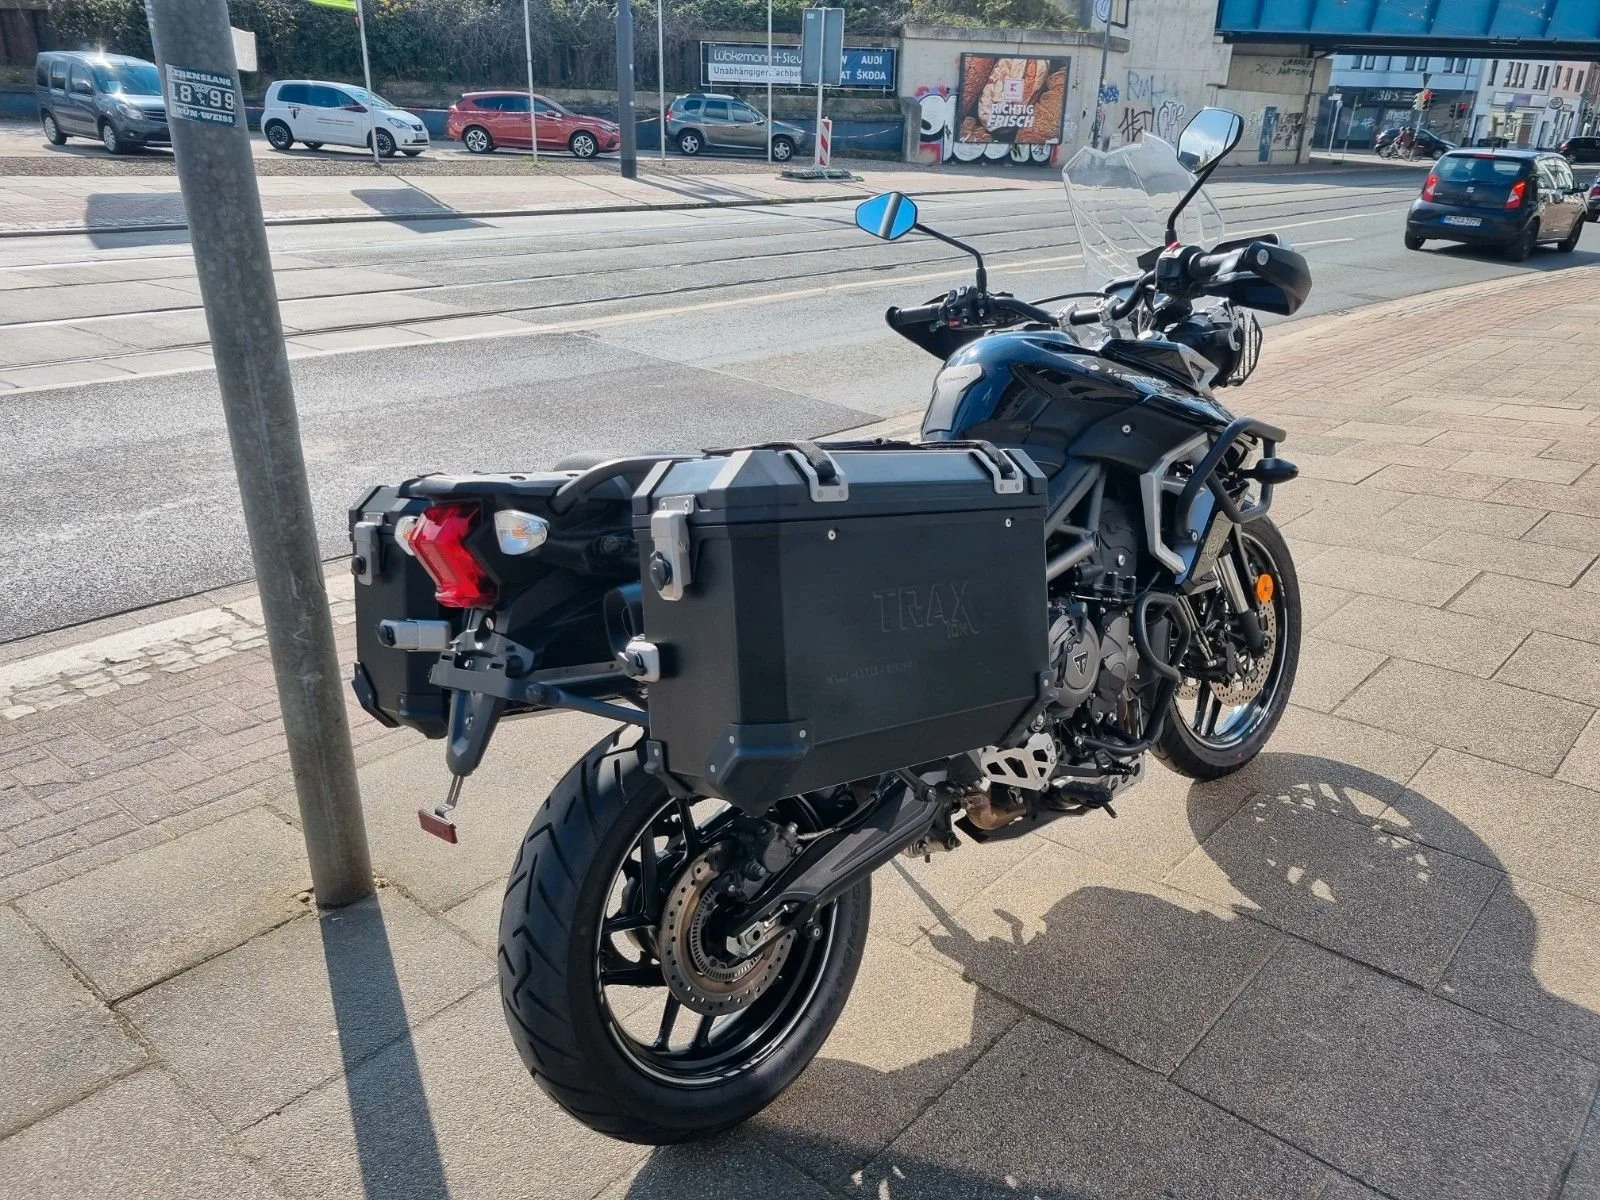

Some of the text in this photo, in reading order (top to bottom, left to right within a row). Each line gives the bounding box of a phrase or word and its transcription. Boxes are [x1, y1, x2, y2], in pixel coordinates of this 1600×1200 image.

[860, 55, 883, 65] AUDI
[713, 66, 768, 77] Unabhängiger
[856, 68, 887, 80] ŠKODA
[991, 104, 1034, 115] RICHTIG
[988, 115, 1035, 128] FRISCH
[872, 580, 980, 634] TRAX
